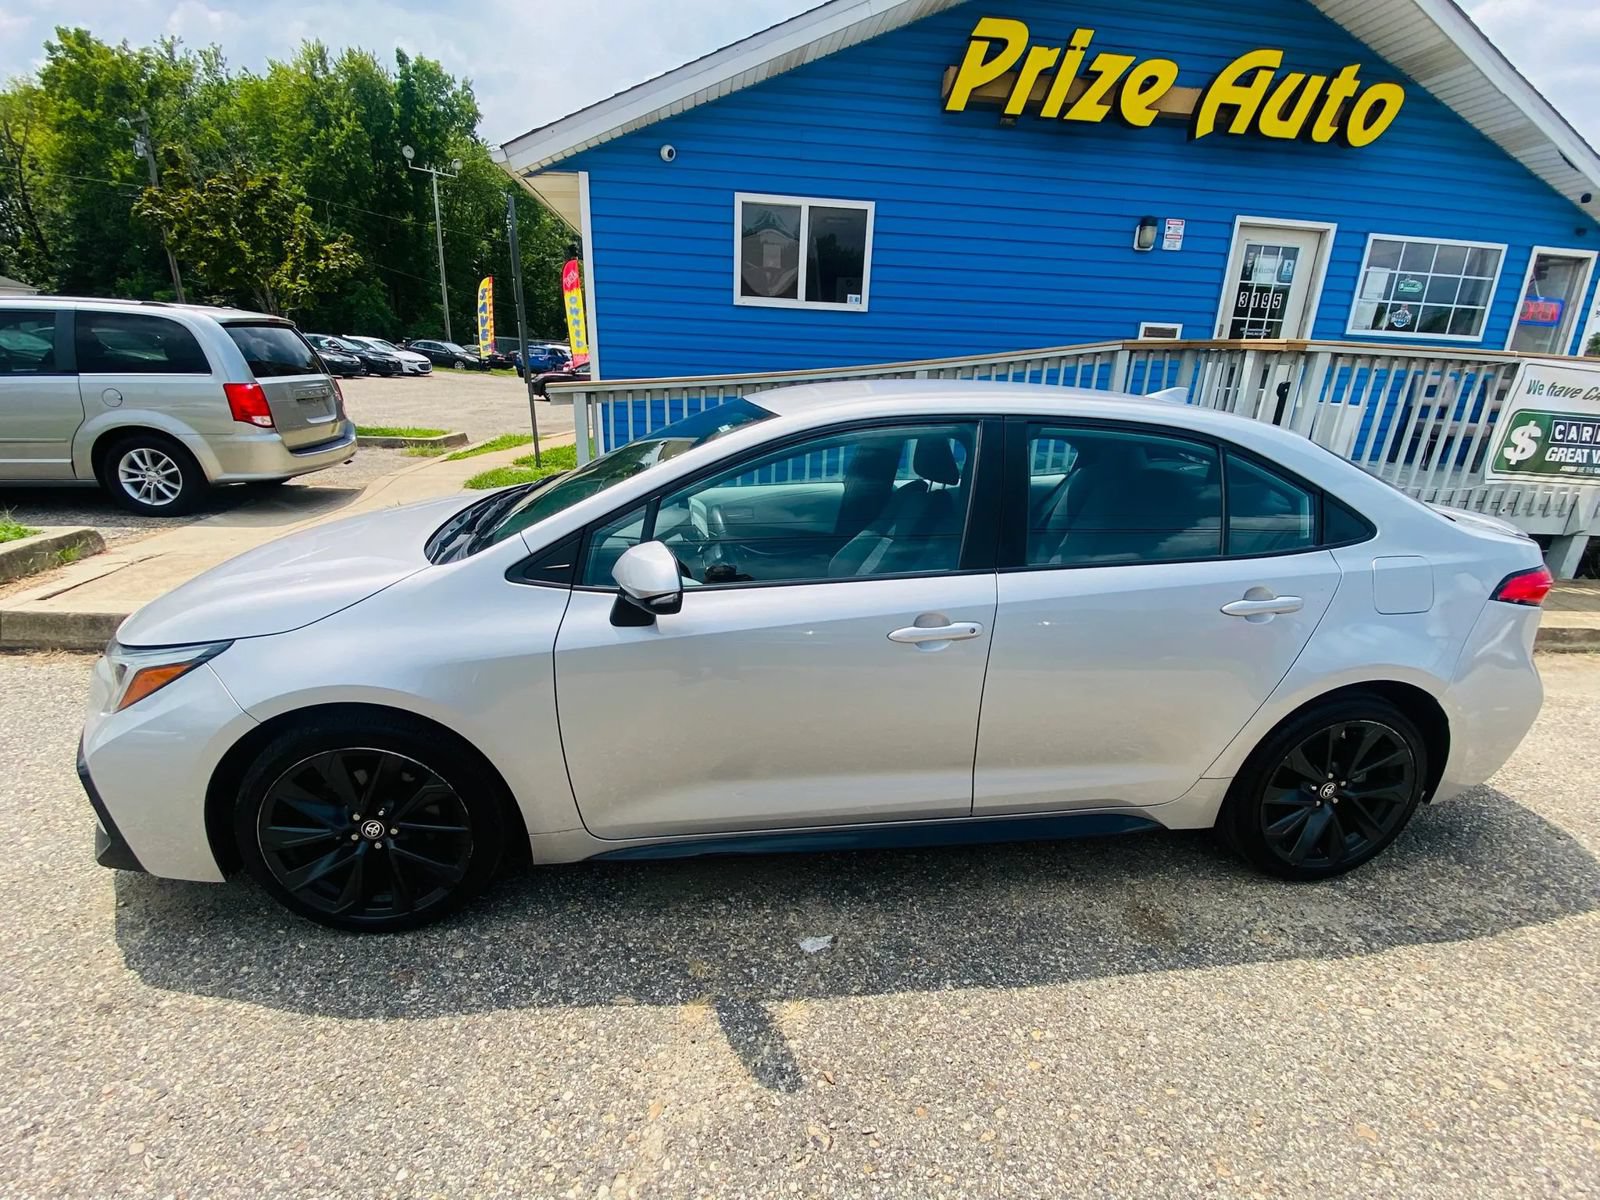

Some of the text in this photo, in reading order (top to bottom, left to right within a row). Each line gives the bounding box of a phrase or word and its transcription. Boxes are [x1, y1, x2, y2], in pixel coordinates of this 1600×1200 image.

[945, 17, 1405, 148] Prize Auto
[1238, 291, 1282, 309] 3195
[479, 287, 490, 342] SAVE
[1526, 379, 1544, 396] We
[1546, 381, 1583, 399] have
[1544, 446, 1590, 464] GREAT
